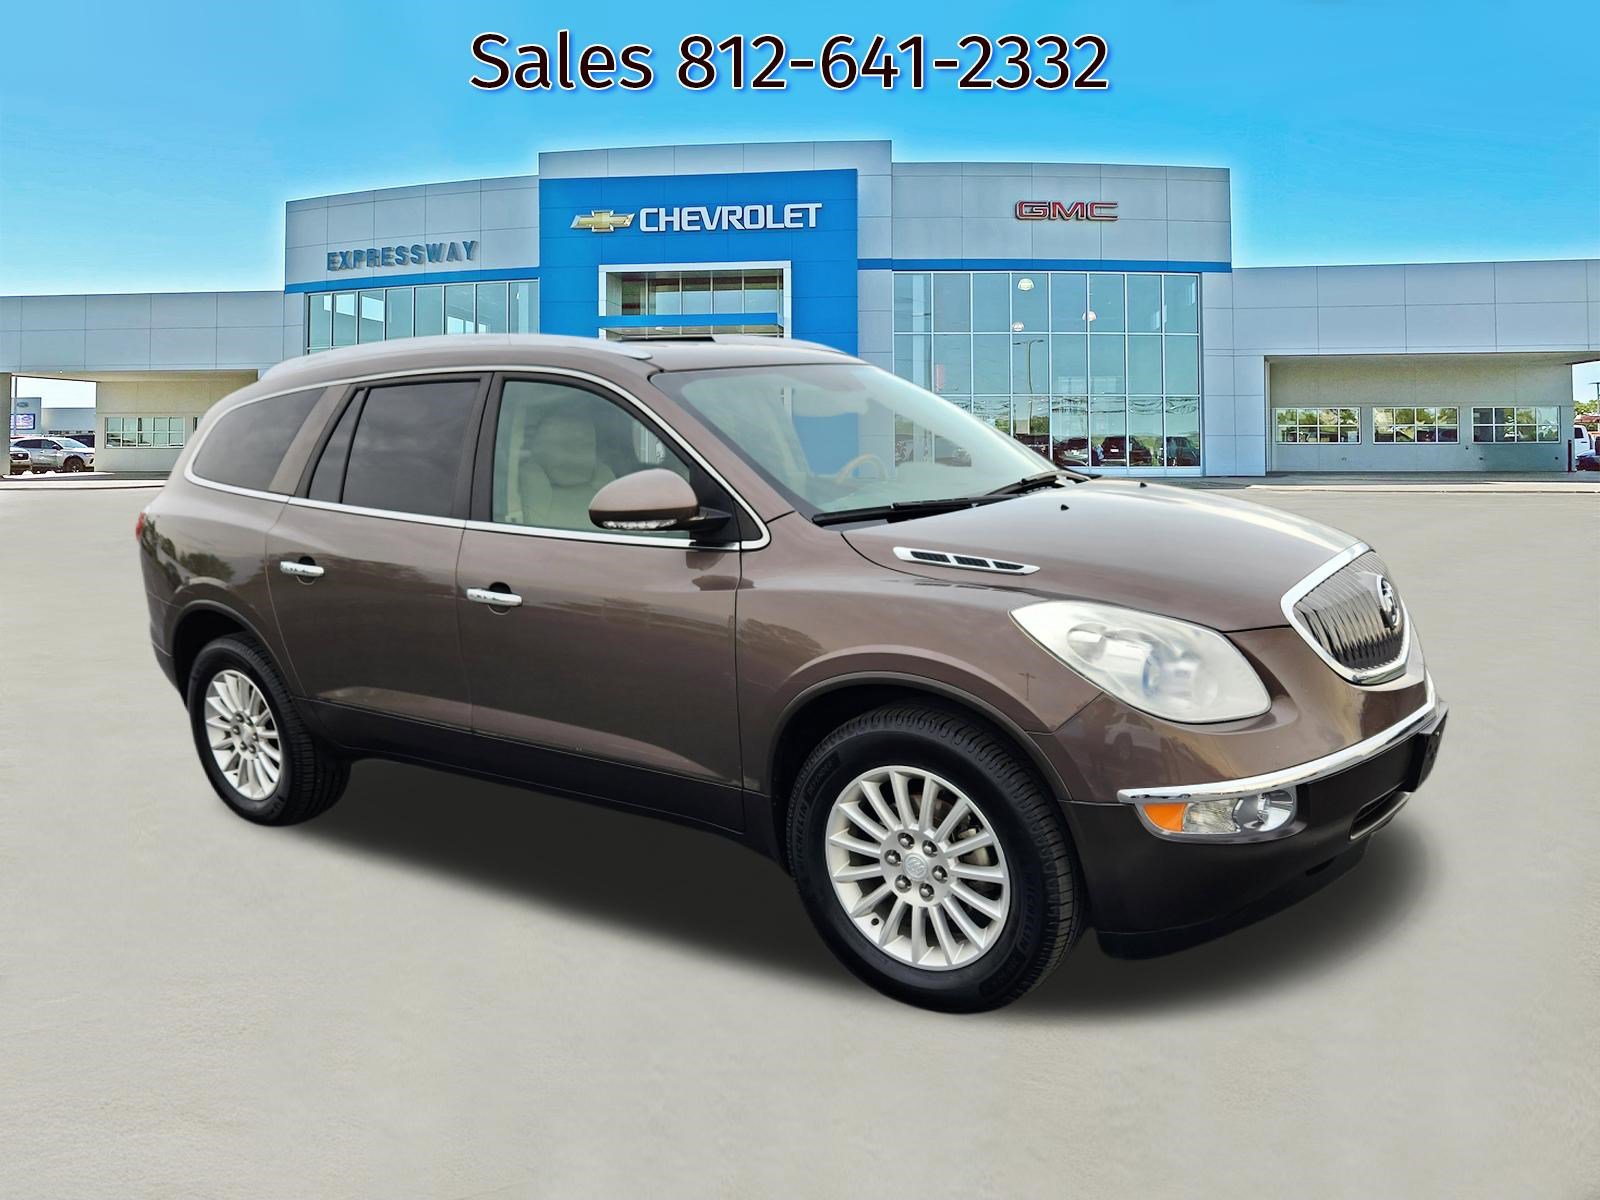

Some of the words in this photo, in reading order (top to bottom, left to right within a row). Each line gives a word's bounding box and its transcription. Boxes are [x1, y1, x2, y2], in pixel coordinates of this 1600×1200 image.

[639, 203, 822, 232] CHEVROLET
[1014, 200, 1120, 221] GMC
[326, 240, 479, 272] EXPRESSWAY
